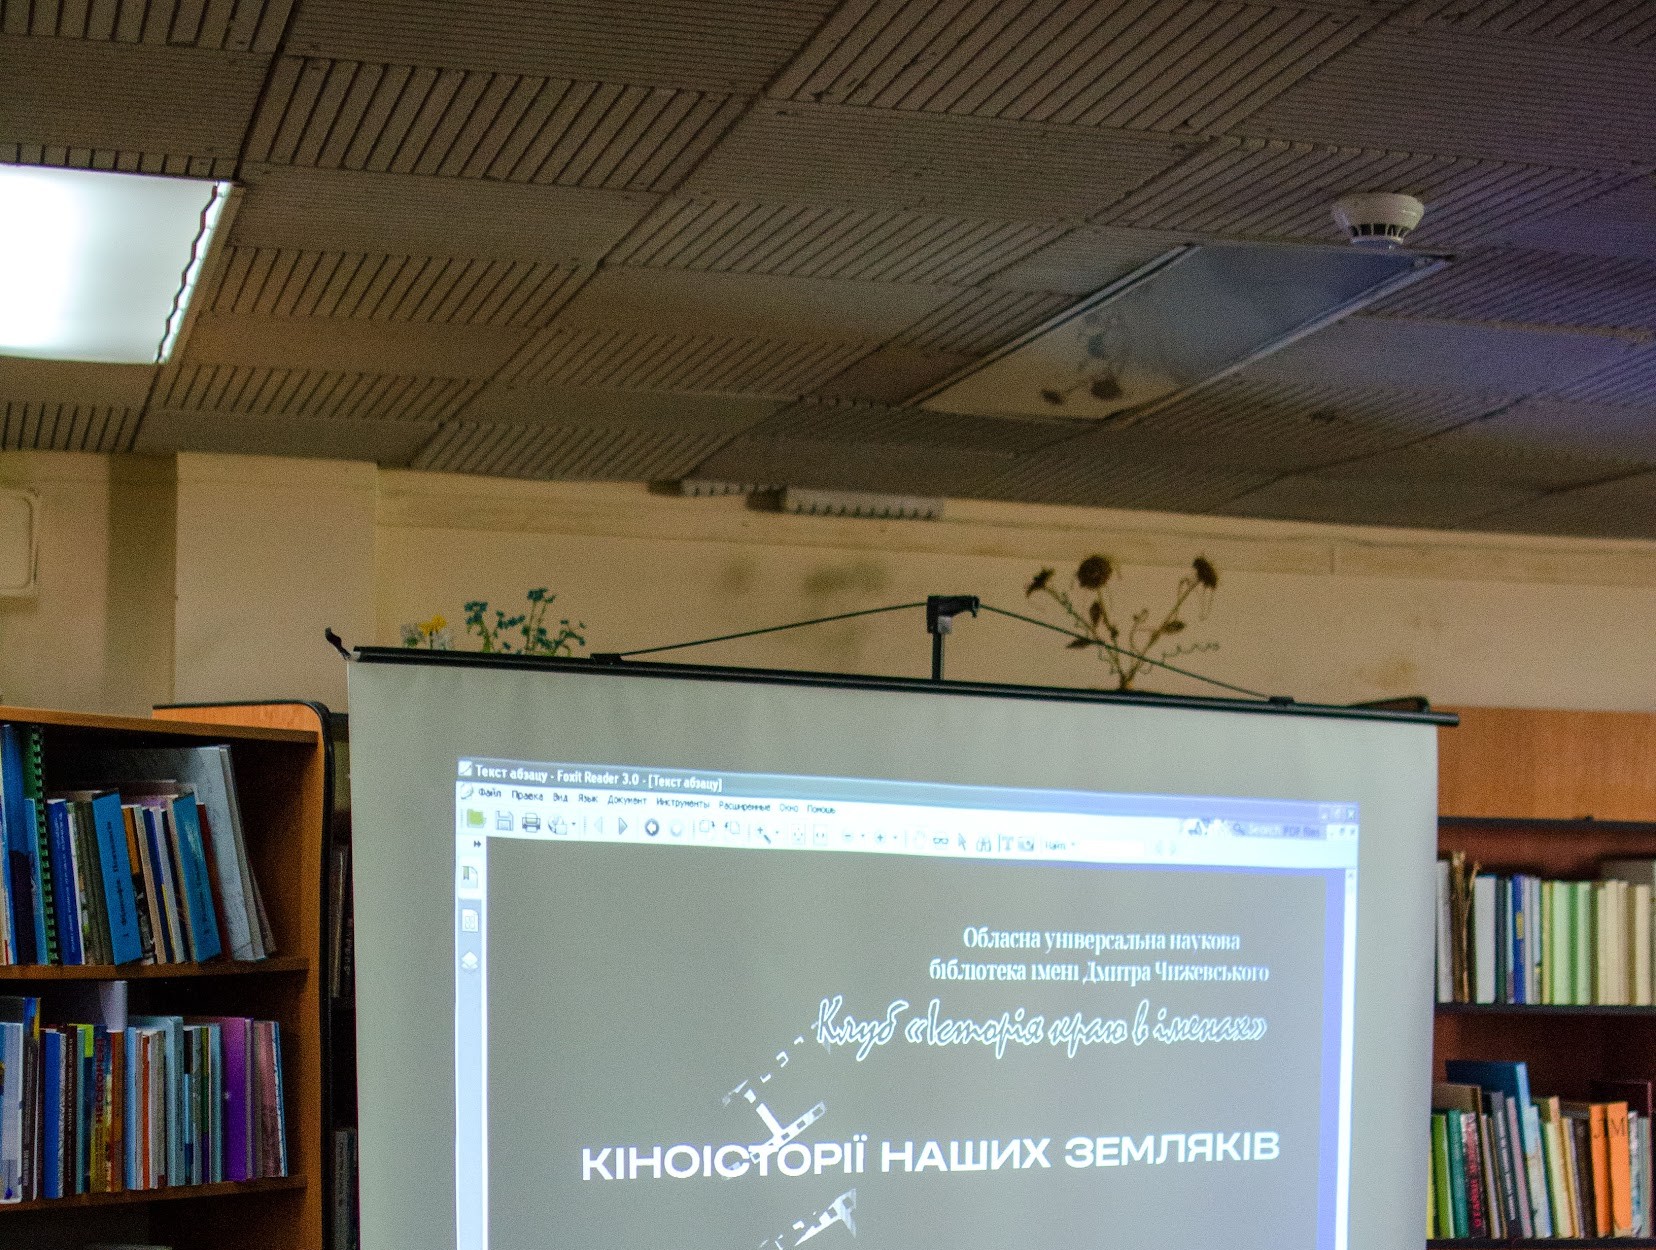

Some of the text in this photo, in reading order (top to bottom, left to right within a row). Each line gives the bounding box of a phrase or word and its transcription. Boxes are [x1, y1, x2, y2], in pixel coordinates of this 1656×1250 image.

[475, 765, 507, 779] Текст
[510, 768, 548, 783] абзацу
[557, 770, 582, 783] Foxit
[584, 771, 619, 785] Reader
[622, 773, 640, 786] 3.0
[648, 773, 682, 788] [Текст
[683, 776, 722, 793] абзацу]
[478, 788, 502, 798] Файл
[511, 790, 544, 801] Правка
[552, 792, 568, 803] Вид
[578, 793, 598, 803] Язык
[607, 794, 647, 805] Документ
[656, 797, 710, 809] Инструменты
[963, 926, 1041, 950] Обласна
[1169, 934, 1241, 955] наукова
[929, 958, 1270, 987] бібліотека імені Дмитра Чижевського
[817, 995, 908, 1061] Клуб
[1048, 1012, 1128, 1058] краю
[1611, 1116, 1626, 1137] М
[582, 1131, 1281, 1181] КІНОІСТОРІЇ НАШИХ ЗЕМЛЯКІВ
